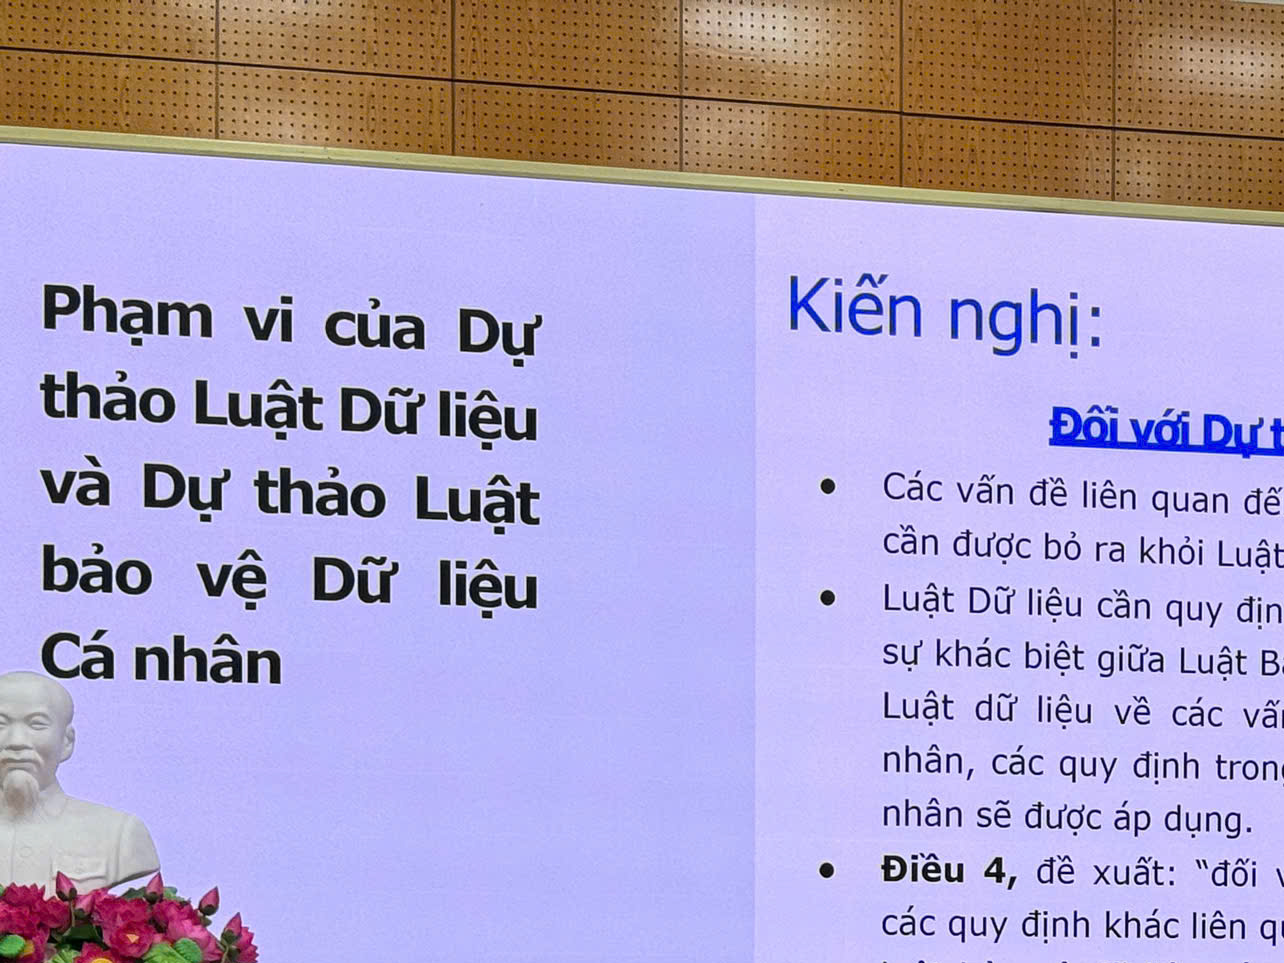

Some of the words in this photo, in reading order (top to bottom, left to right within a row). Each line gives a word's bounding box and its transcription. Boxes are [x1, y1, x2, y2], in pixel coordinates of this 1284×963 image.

[43, 284, 213, 347] Phạm
[243, 295, 293, 343] vi
[324, 297, 425, 350] của
[459, 308, 543, 368] Dự
[790, 272, 922, 338] Kiến
[950, 287, 1101, 360] nghị:
[39, 370, 176, 424] thảo
[195, 378, 324, 441] Luật
[340, 387, 426, 435] Dữ
[439, 389, 537, 451] liệu
[1049, 404, 1119, 447] Đối
[1129, 408, 1190, 450] với
[1203, 413, 1264, 458] Dự
[39, 454, 110, 506] và
[143, 463, 232, 523] Dự
[253, 466, 386, 519] thảo
[416, 474, 540, 535] Luật
[883, 469, 943, 502] Các
[956, 473, 1014, 505] vấn
[1029, 476, 1068, 507] đề
[1083, 479, 1137, 511] liên
[1151, 490, 1229, 519] quan
[883, 523, 939, 556] cần
[952, 528, 1032, 565] được
[1044, 530, 1082, 561] bỏ
[1095, 541, 1125, 563] ra
[1139, 535, 1204, 566] khỏi
[42, 542, 153, 596] bảo
[196, 548, 267, 611] vệ
[313, 555, 400, 604] Dữ
[439, 558, 537, 619] liệu
[41, 629, 115, 680] Cá
[135, 633, 281, 685] nhân
[883, 797, 963, 828] nhân
[976, 799, 1012, 829] sẽ
[1024, 801, 1102, 837] được
[1113, 799, 1151, 838] áp
[1164, 804, 1252, 840] dụng.
[880, 852, 964, 883] Điều
[983, 856, 1017, 891] 4,
[1036, 854, 1075, 885] đề
[1093, 855, 1175, 887] xuất:
[1195, 857, 1257, 888] “đối
